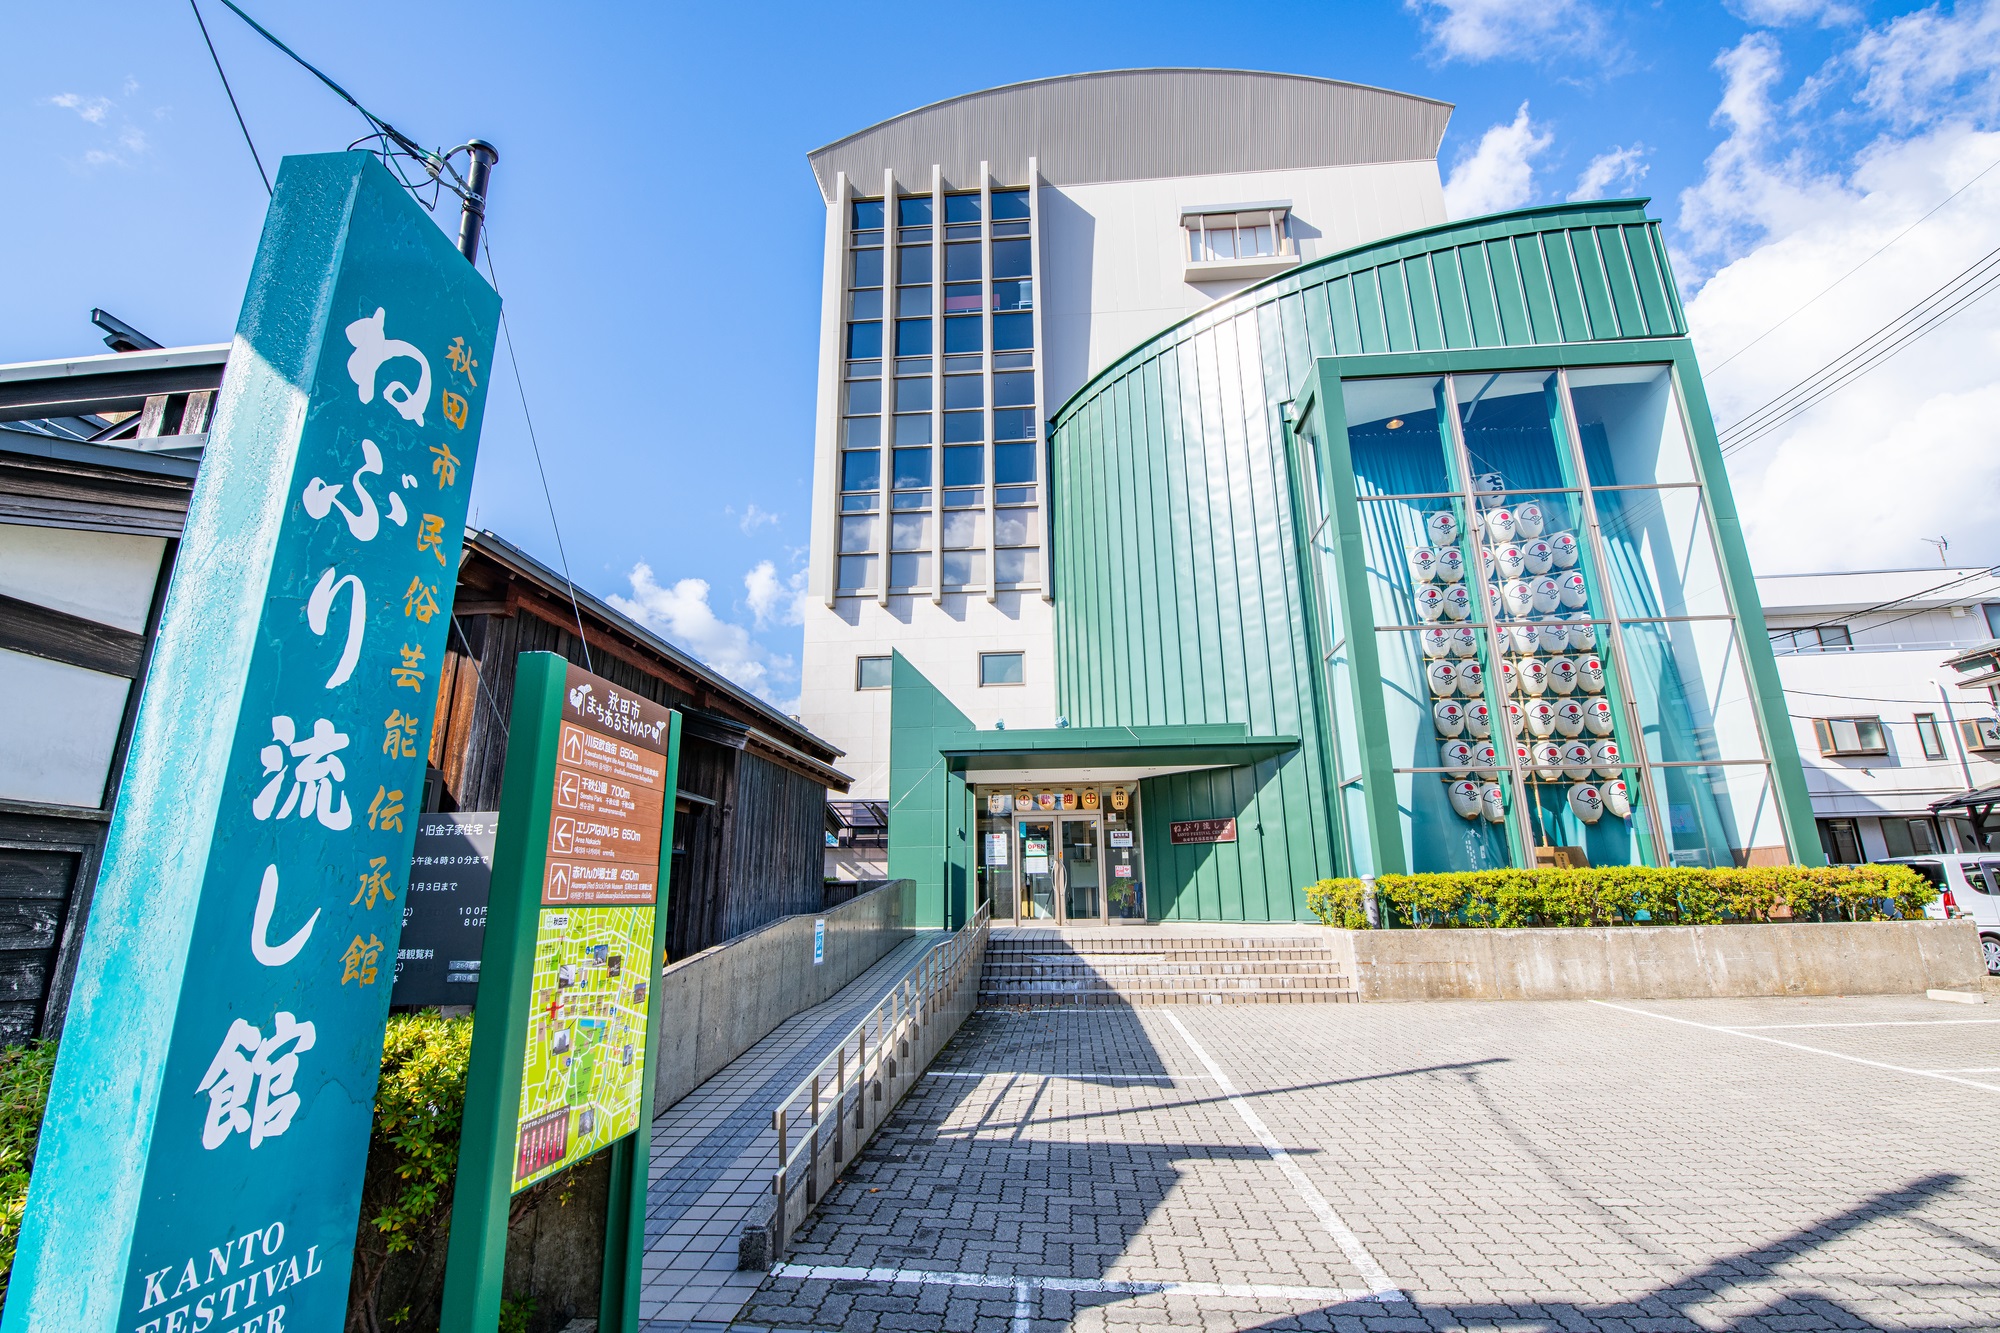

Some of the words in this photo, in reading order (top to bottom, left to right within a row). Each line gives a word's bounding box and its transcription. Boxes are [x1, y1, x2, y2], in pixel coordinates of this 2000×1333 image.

[339, 335, 480, 989] 秋田市民俗芸能伝承館
[608, 690, 641, 720] 秋田市
[586, 696, 651, 738] まちあるきMAP
[197, 307, 432, 1151] ねぶり流し館
[620, 746, 639, 762] 850m
[581, 777, 607, 794] 千秋公園
[611, 785, 630, 800] 700m
[576, 821, 619, 839] エリアなかいち
[622, 829, 641, 842] 650m
[572, 866, 618, 881] 赤れんが郷土館
[620, 869, 640, 881] 450m
[407, 882, 458, 891] 1月3日まで
[458, 906, 488, 916] 100円
[463, 917, 487, 927] 80円
[138, 1221, 285, 1314] KANTO
